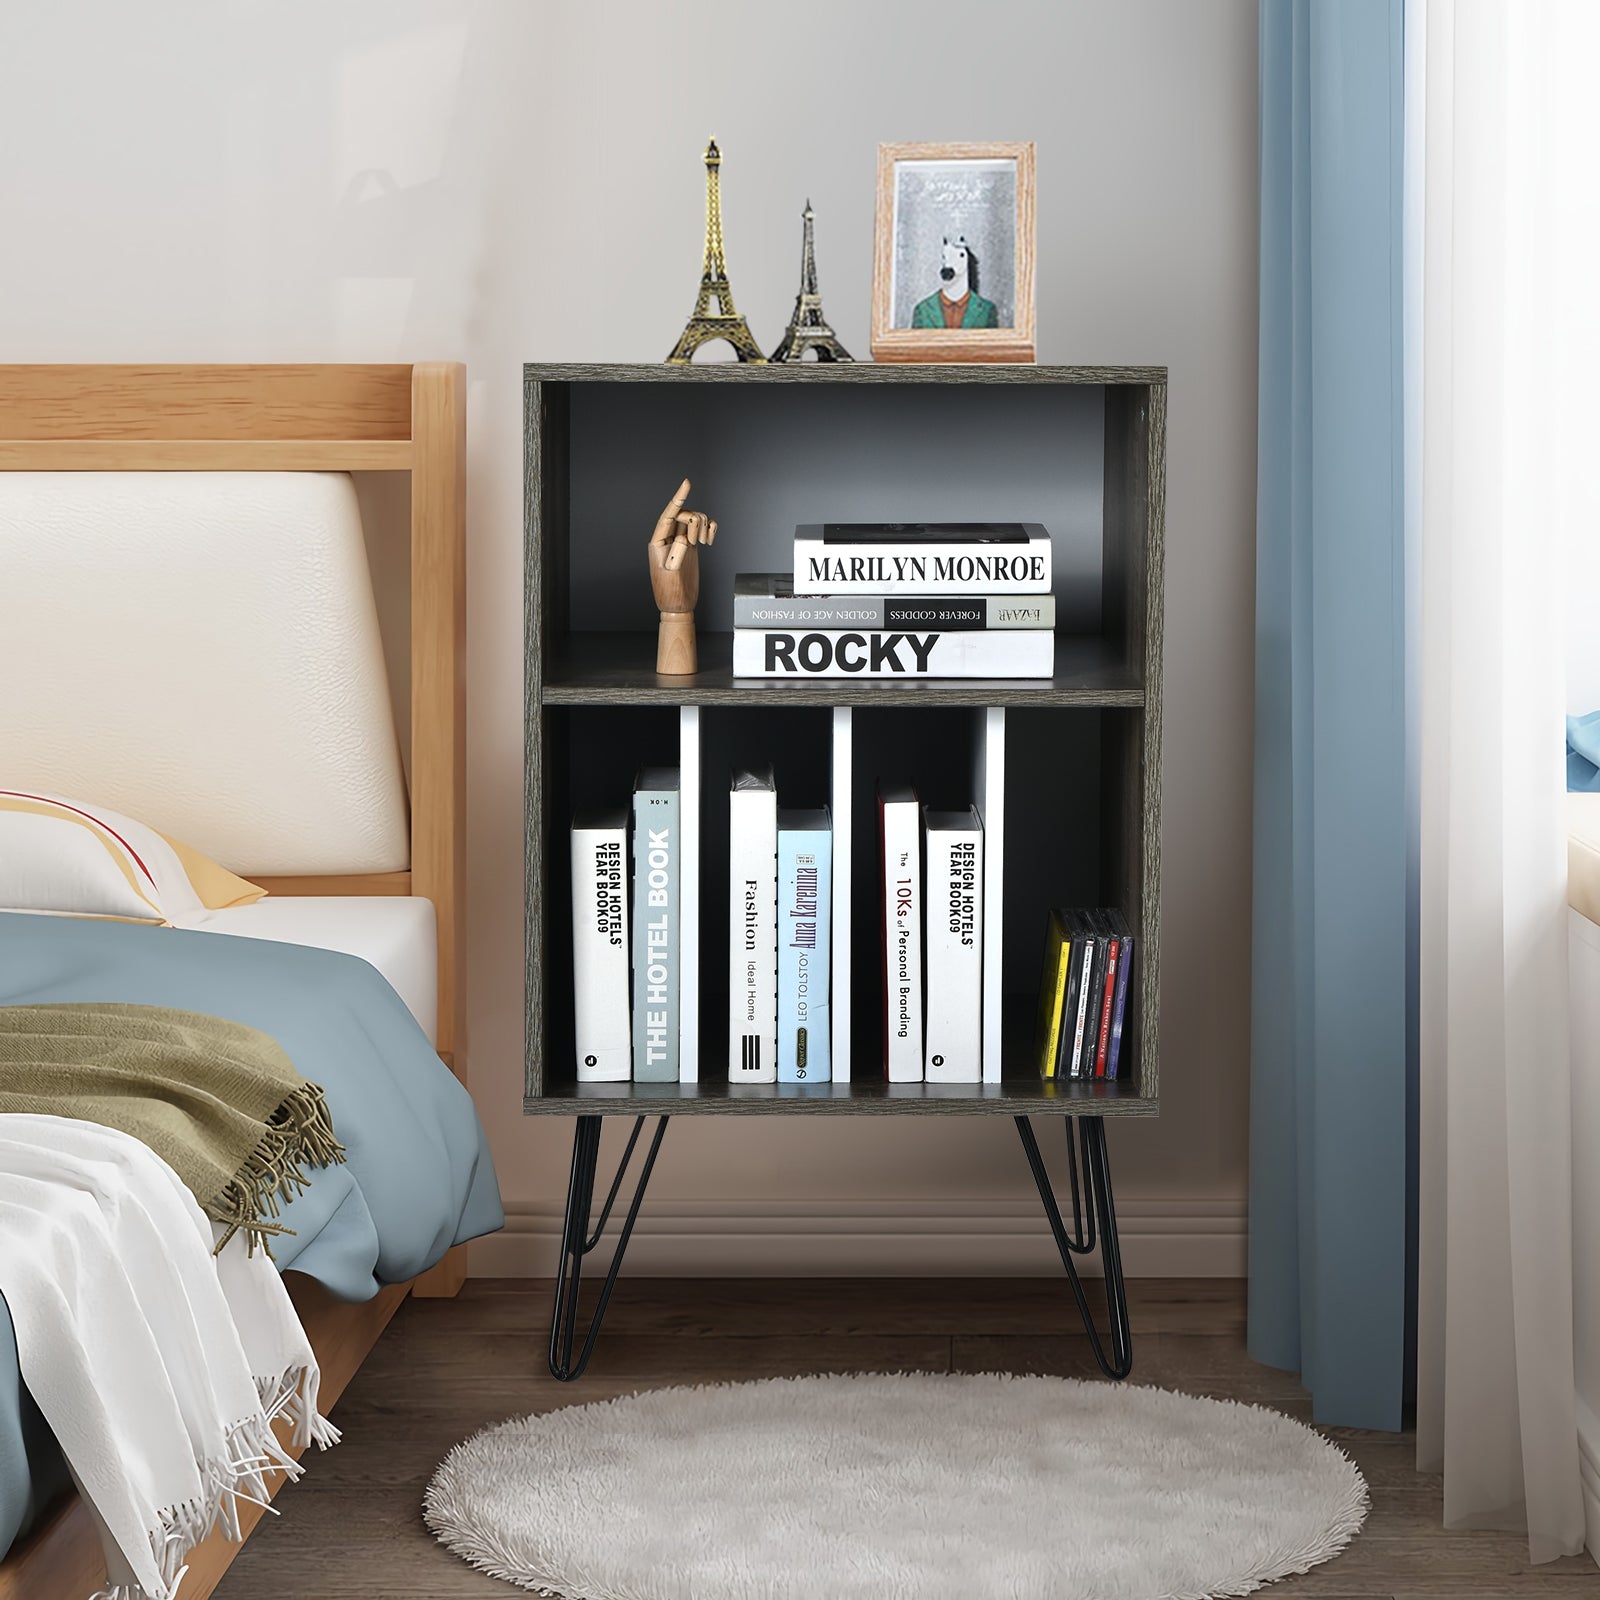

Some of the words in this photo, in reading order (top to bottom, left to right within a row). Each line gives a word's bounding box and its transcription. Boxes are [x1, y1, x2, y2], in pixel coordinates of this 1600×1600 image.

[809, 555, 927, 582] MARILYN
[934, 555, 1045, 582] MONROE
[752, 609, 795, 620] FASHION
[798, 609, 811, 620] OF
[814, 609, 833, 620] AGE
[836, 609, 877, 620] GOLDEN
[890, 610, 937, 620] GODDESS
[940, 610, 980, 620] FOREVER
[998, 609, 1041, 621] BAZAAR
[764, 633, 940, 673] ROCKY
[595, 842, 608, 877] YEAR
[608, 842, 621, 890] DESIGN
[648, 828, 669, 907] BOOK
[900, 852, 909, 867] The
[950, 842, 962, 876] YEAR
[962, 842, 975, 890] DESIGN
[790, 867, 818, 918] Karenina
[609, 895, 622, 945] HOTELS
[745, 880, 759, 951] Fashion
[897, 919, 905, 928] of
[961, 895, 974, 945] HOTELS
[789, 922, 816, 949] Anna
[647, 914, 669, 1004] HOTEL
[898, 930, 911, 981] Personal
[747, 961, 755, 987] Ideal
[798, 952, 808, 998] TOLSTOY
[747, 991, 755, 1021] Home
[798, 1001, 807, 1021] LEO
[898, 987, 911, 1038] Branding
[646, 1011, 668, 1065] THE
